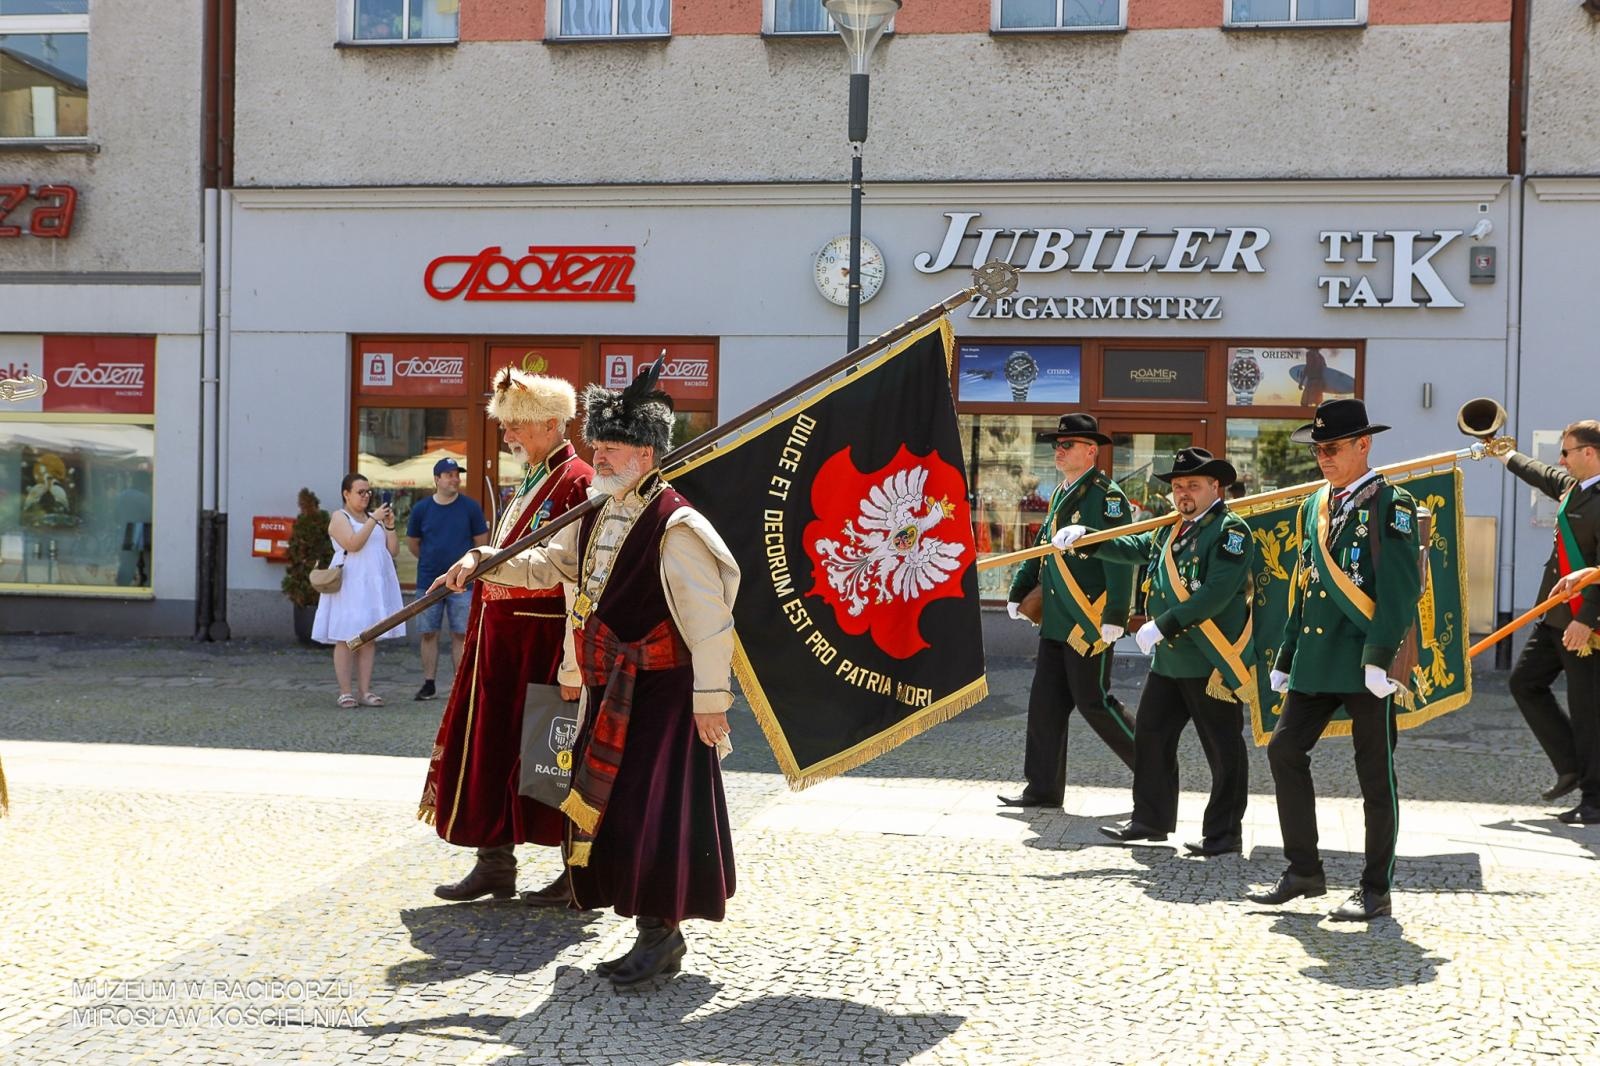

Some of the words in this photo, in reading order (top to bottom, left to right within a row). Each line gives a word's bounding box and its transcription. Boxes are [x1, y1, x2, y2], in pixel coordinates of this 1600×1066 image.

[913, 212, 1271, 274] JUBILER
[967, 294, 1223, 320] ZEGARMISTRZ
[1261, 351, 1301, 360] ORIENT
[1130, 368, 1177, 380] ROAMER
[778, 413, 817, 473] DULCE
[768, 475, 792, 501] ET
[763, 509, 795, 598] DECORUM
[782, 598, 813, 633] EST
[804, 630, 838, 666] PRO
[835, 658, 892, 697] PATRIA
[895, 681, 933, 707] MORI
[535, 763, 571, 777] RACIB
